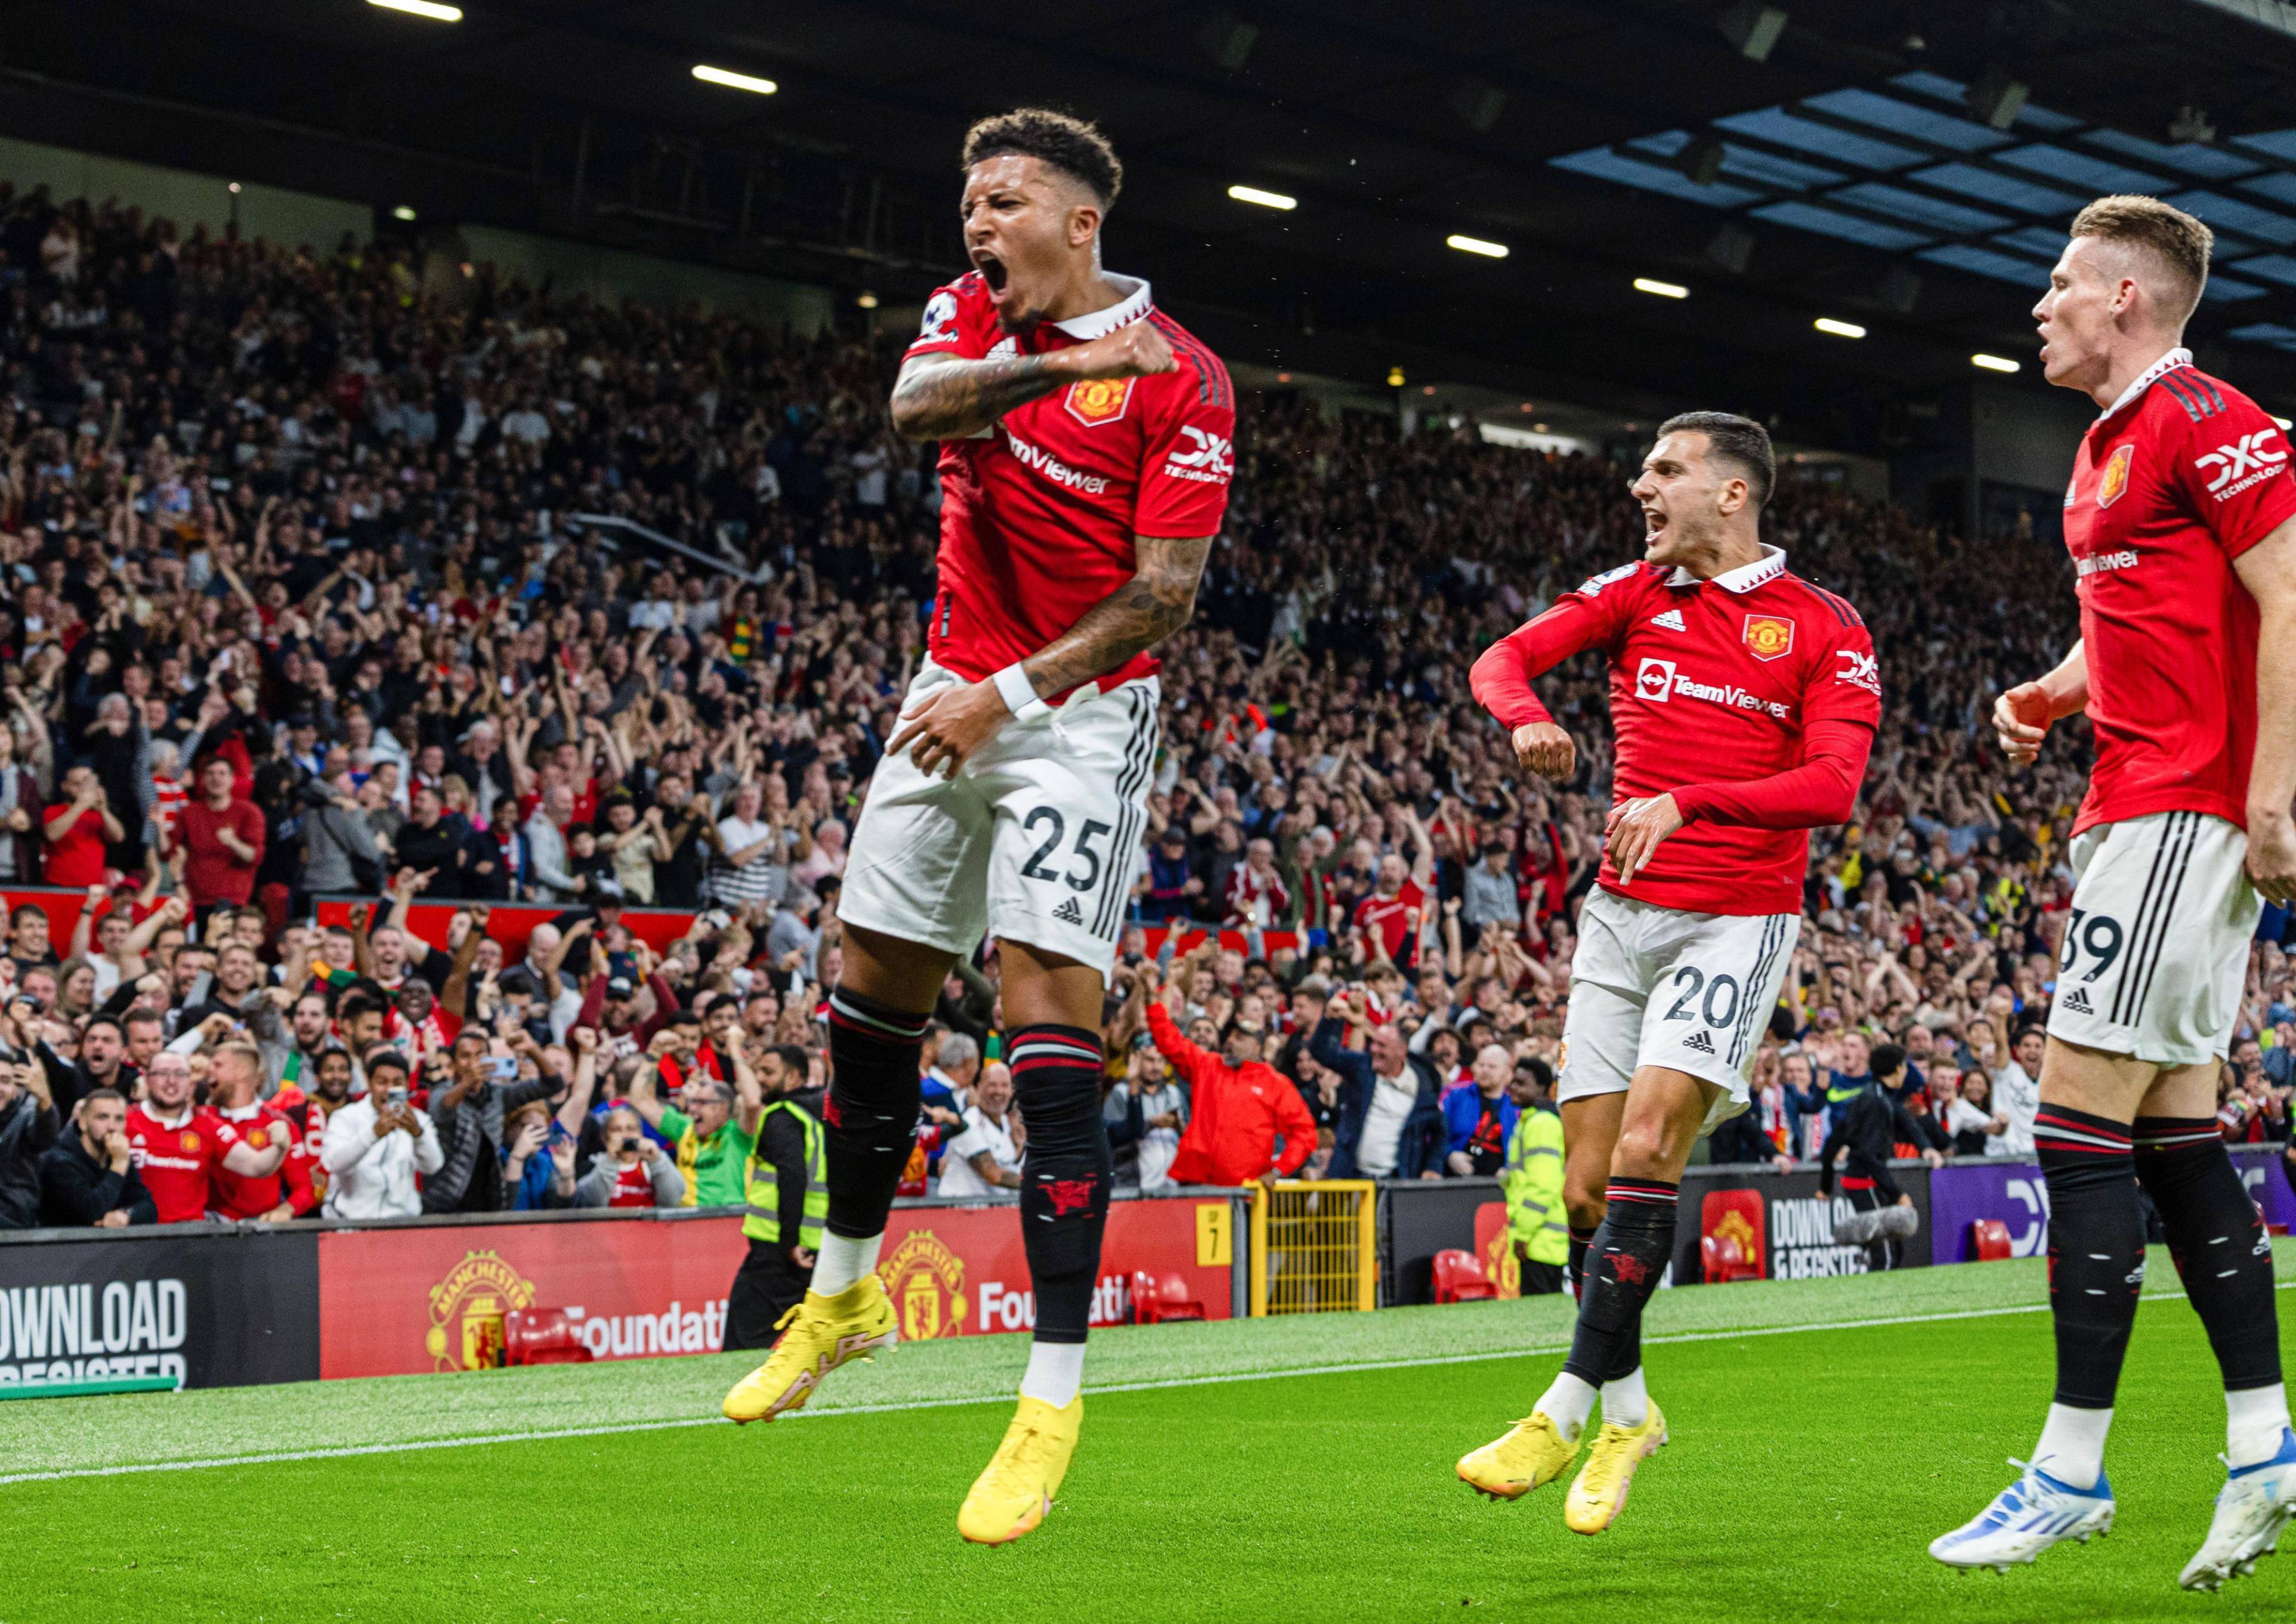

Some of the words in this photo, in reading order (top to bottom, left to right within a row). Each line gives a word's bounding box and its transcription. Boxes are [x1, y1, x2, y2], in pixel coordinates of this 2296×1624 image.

[1007, 431, 1111, 494] mViewer
[2195, 428, 2288, 492] DXC
[1674, 674, 1790, 718] TeamViewer
[1021, 806, 1112, 891] 25
[1663, 966, 1739, 1029] 20
[1682, 1040, 1716, 1054] adidas
[1209, 1227, 1218, 1260] 7
